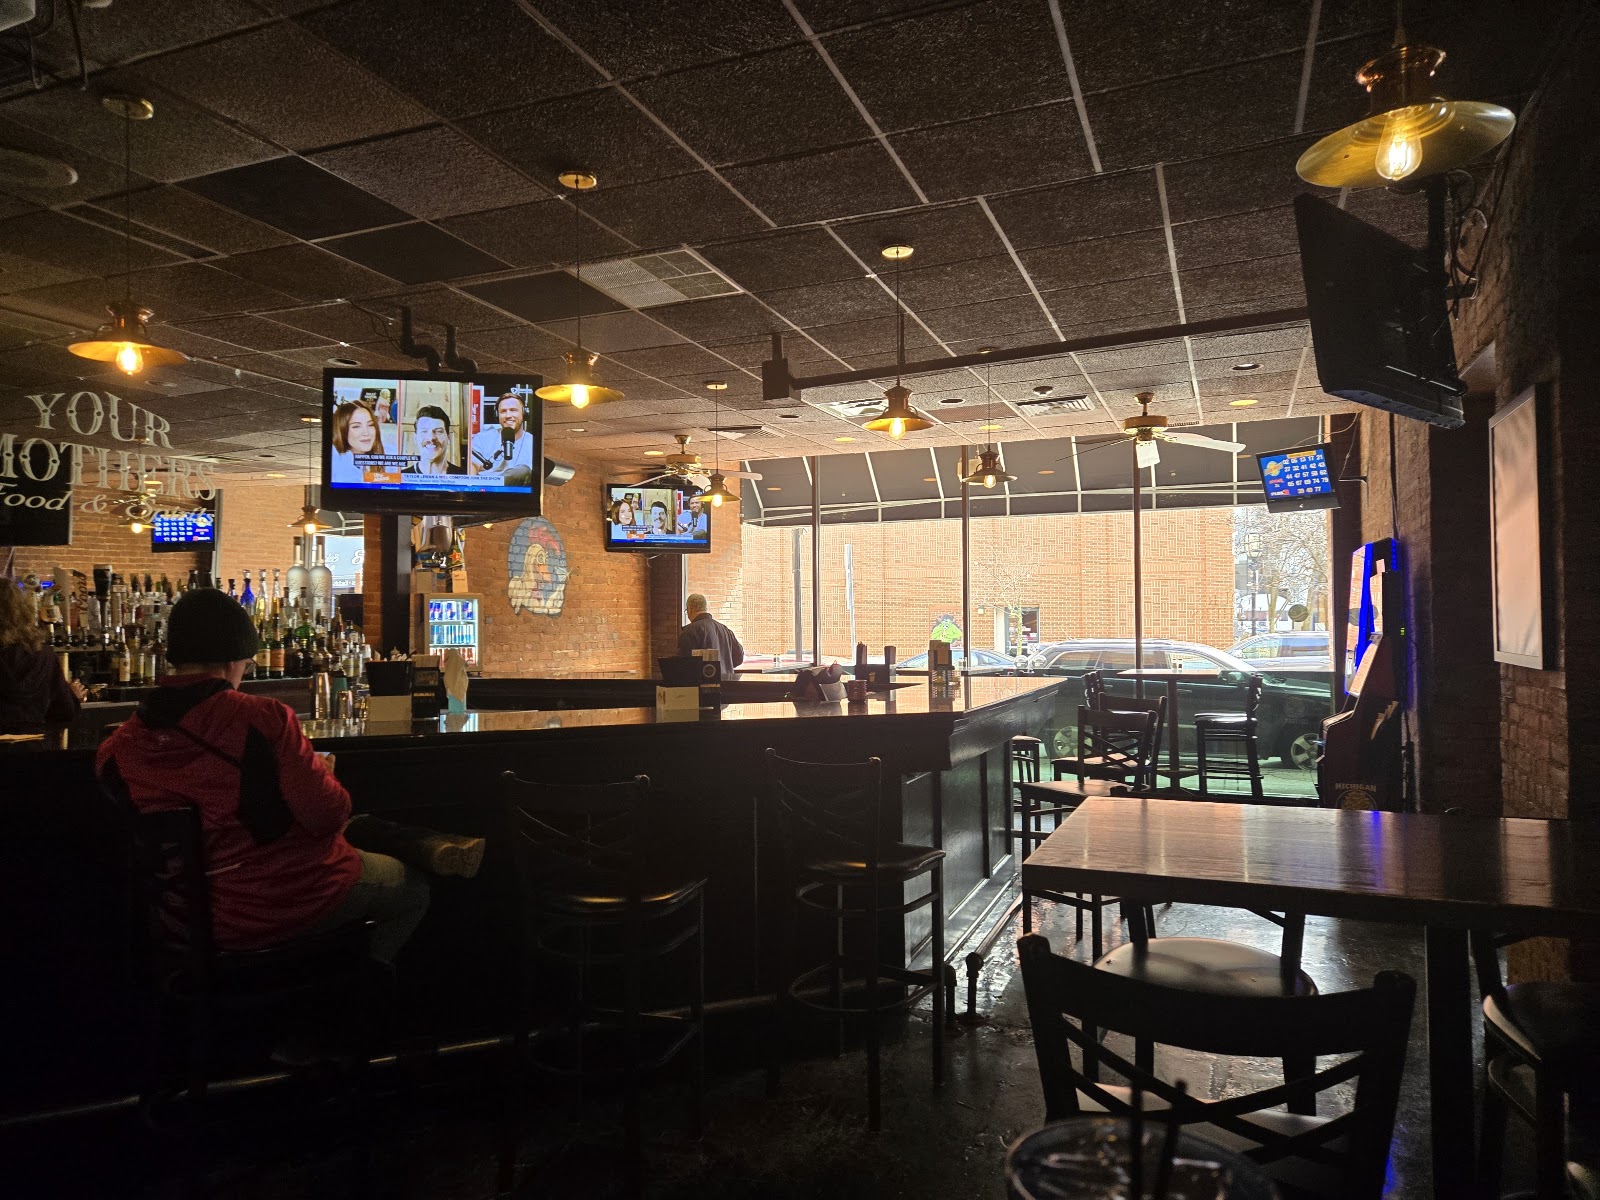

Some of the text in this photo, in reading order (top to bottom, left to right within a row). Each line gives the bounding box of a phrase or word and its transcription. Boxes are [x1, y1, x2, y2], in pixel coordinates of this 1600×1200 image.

[25, 391, 174, 449] YOUR
[81, 494, 109, 514] &
[1335, 782, 1377, 792] MICHIGAN
